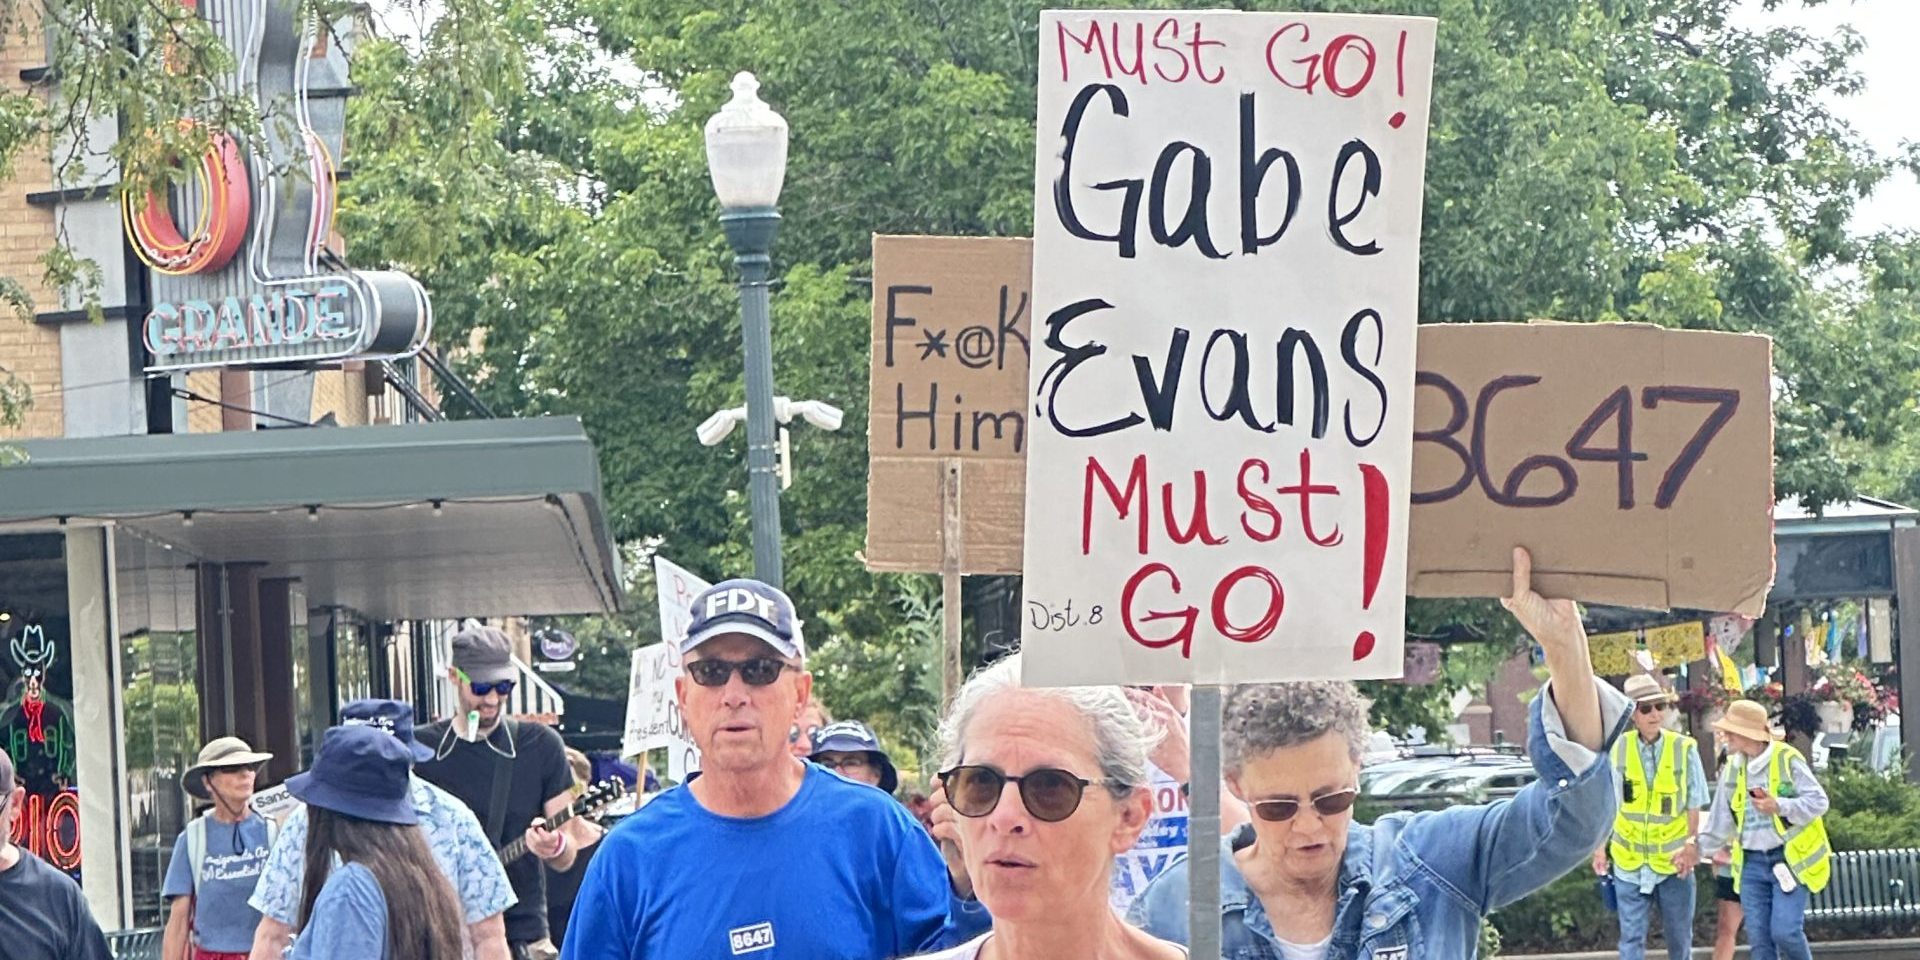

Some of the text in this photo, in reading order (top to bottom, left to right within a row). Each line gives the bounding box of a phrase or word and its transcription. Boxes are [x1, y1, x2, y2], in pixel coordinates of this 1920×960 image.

[1265, 22, 1407, 129] GO!
[1053, 82, 1384, 259] Gabe
[143, 286, 352, 356] GRANDE
[1035, 298, 1388, 448] Evans
[896, 381, 1025, 454] Him
[706, 588, 775, 620] FDT
[1089, 605, 1103, 625] 8
[733, 928, 771, 949] 8647
